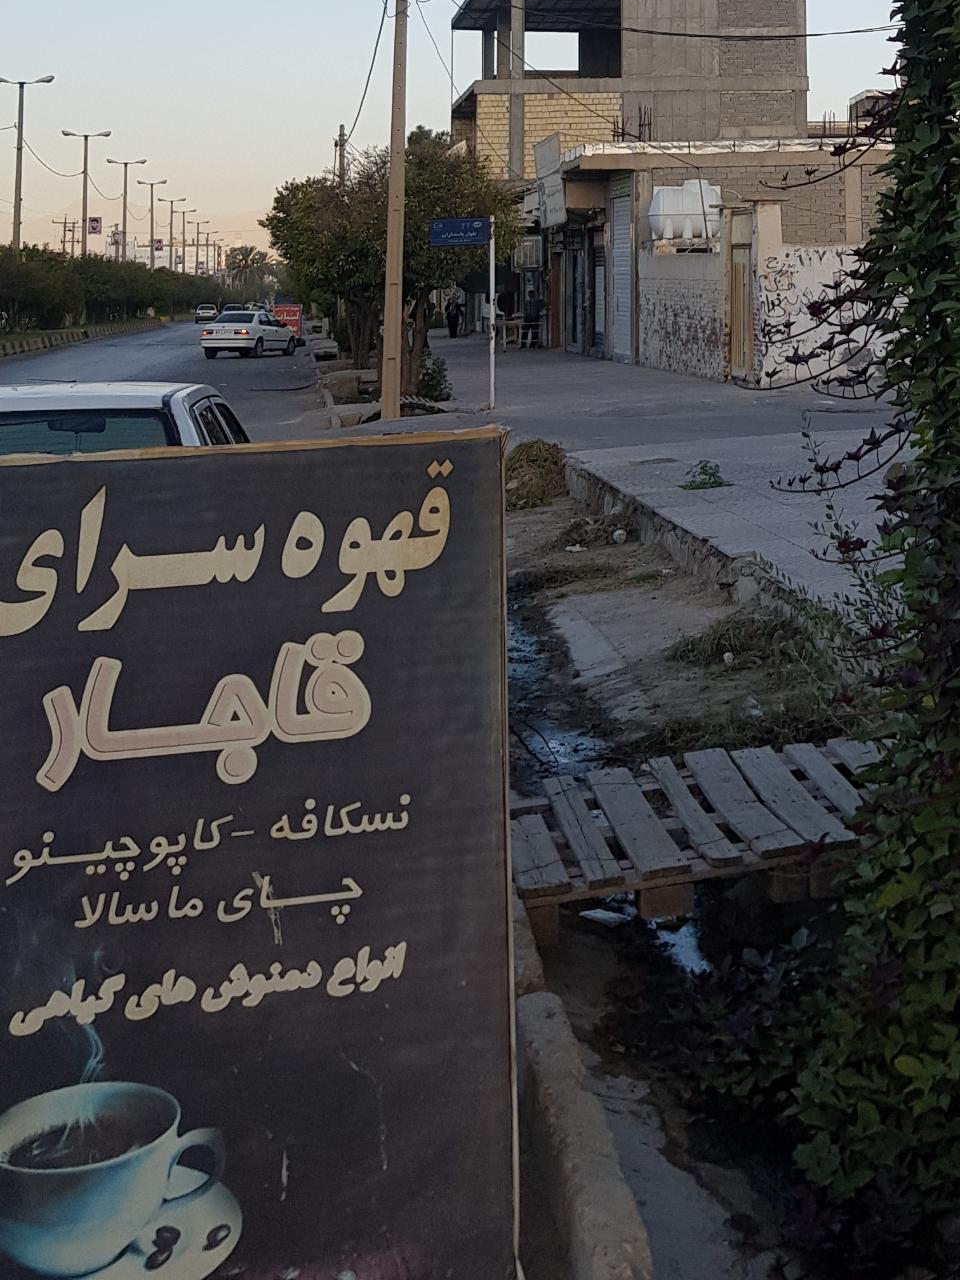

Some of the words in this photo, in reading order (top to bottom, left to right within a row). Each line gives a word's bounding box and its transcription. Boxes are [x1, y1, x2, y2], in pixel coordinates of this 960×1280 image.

[0, 485, 265, 637] سرای
[281, 458, 455, 613] قهوه
[36, 629, 372, 792] قاجار
[269, 793, 411, 841] نسکافه
[216, 874, 364, 925] چای
[124, 968, 197, 1020] های
[201, 961, 322, 1012] دمنوش
[326, 941, 407, 997] انواع
[9, 973, 126, 1037] گیاهی
